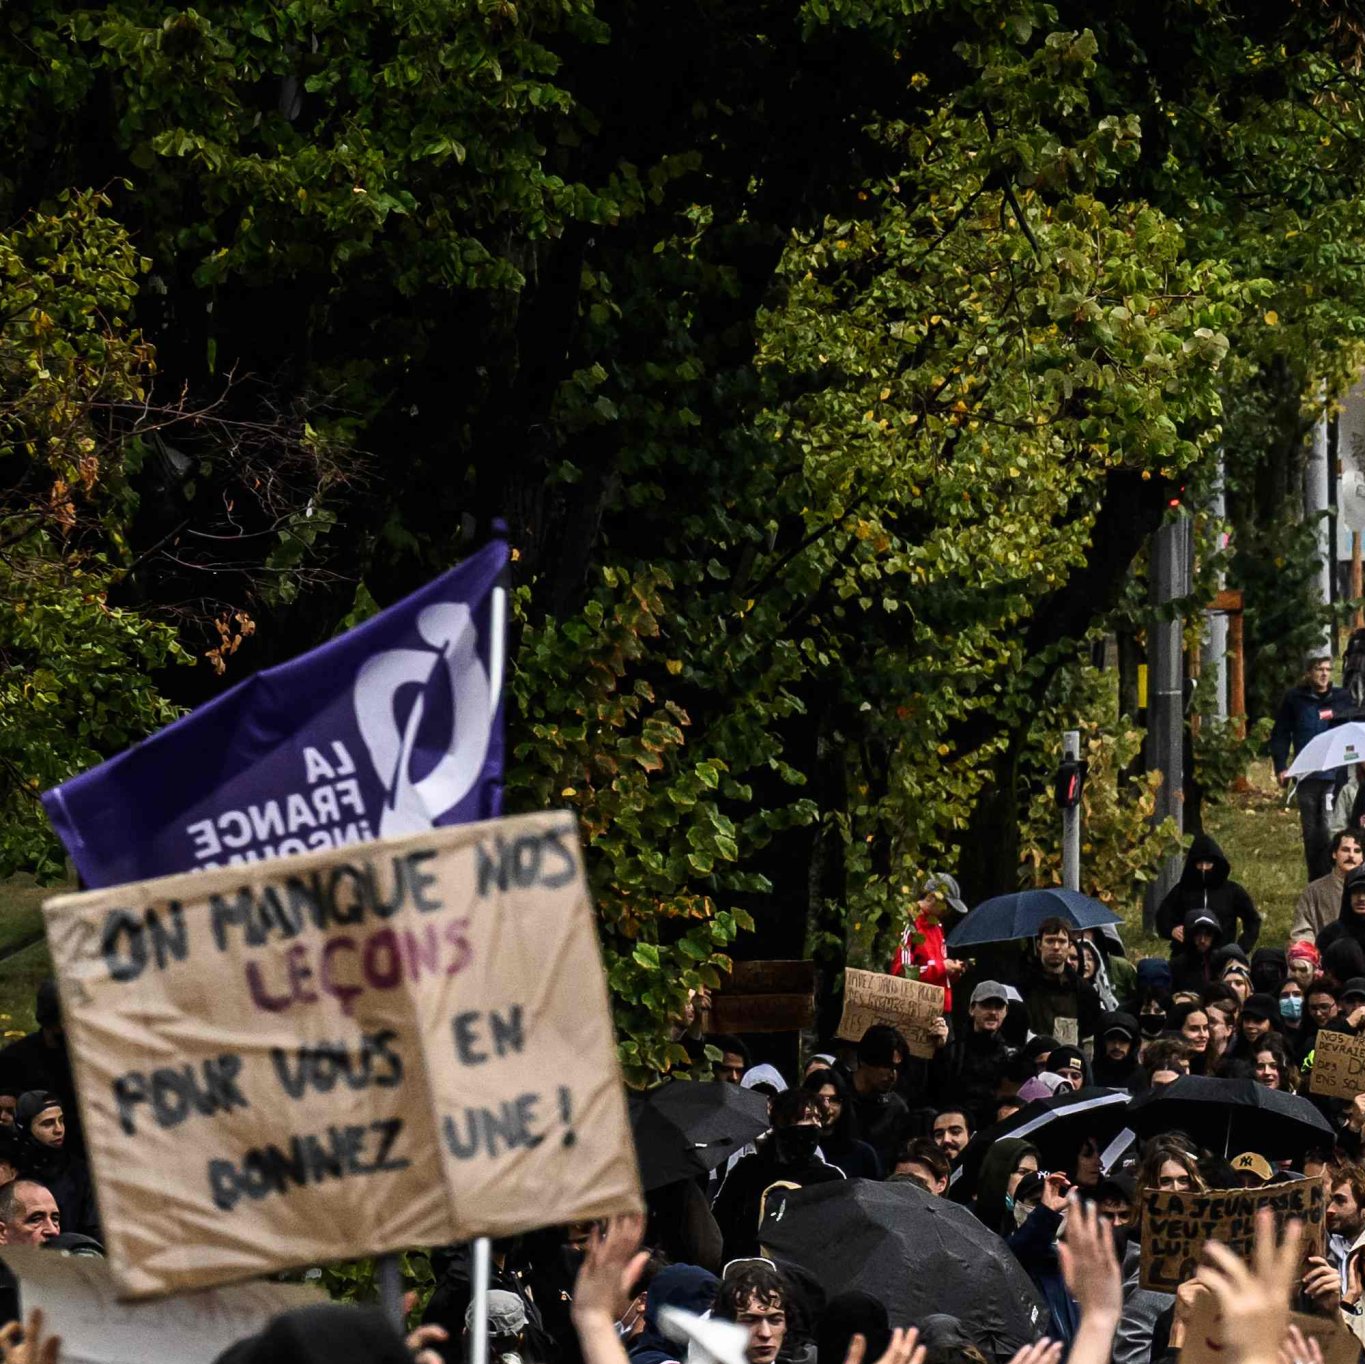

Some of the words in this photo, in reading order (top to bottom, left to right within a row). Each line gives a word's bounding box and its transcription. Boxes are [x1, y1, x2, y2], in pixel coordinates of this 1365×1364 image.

[101, 900, 189, 983] ON
[208, 850, 440, 952] MANQUE
[474, 827, 577, 899] NOS
[245, 918, 474, 1017] LEÇONS
[111, 1052, 248, 1137] POUR
[271, 1029, 405, 1099] VOUS
[451, 1005, 526, 1066] EN
[1317, 1060, 1338, 1072] DES
[1320, 1031, 1345, 1043] NOS
[208, 1117, 411, 1211] DONNEZ
